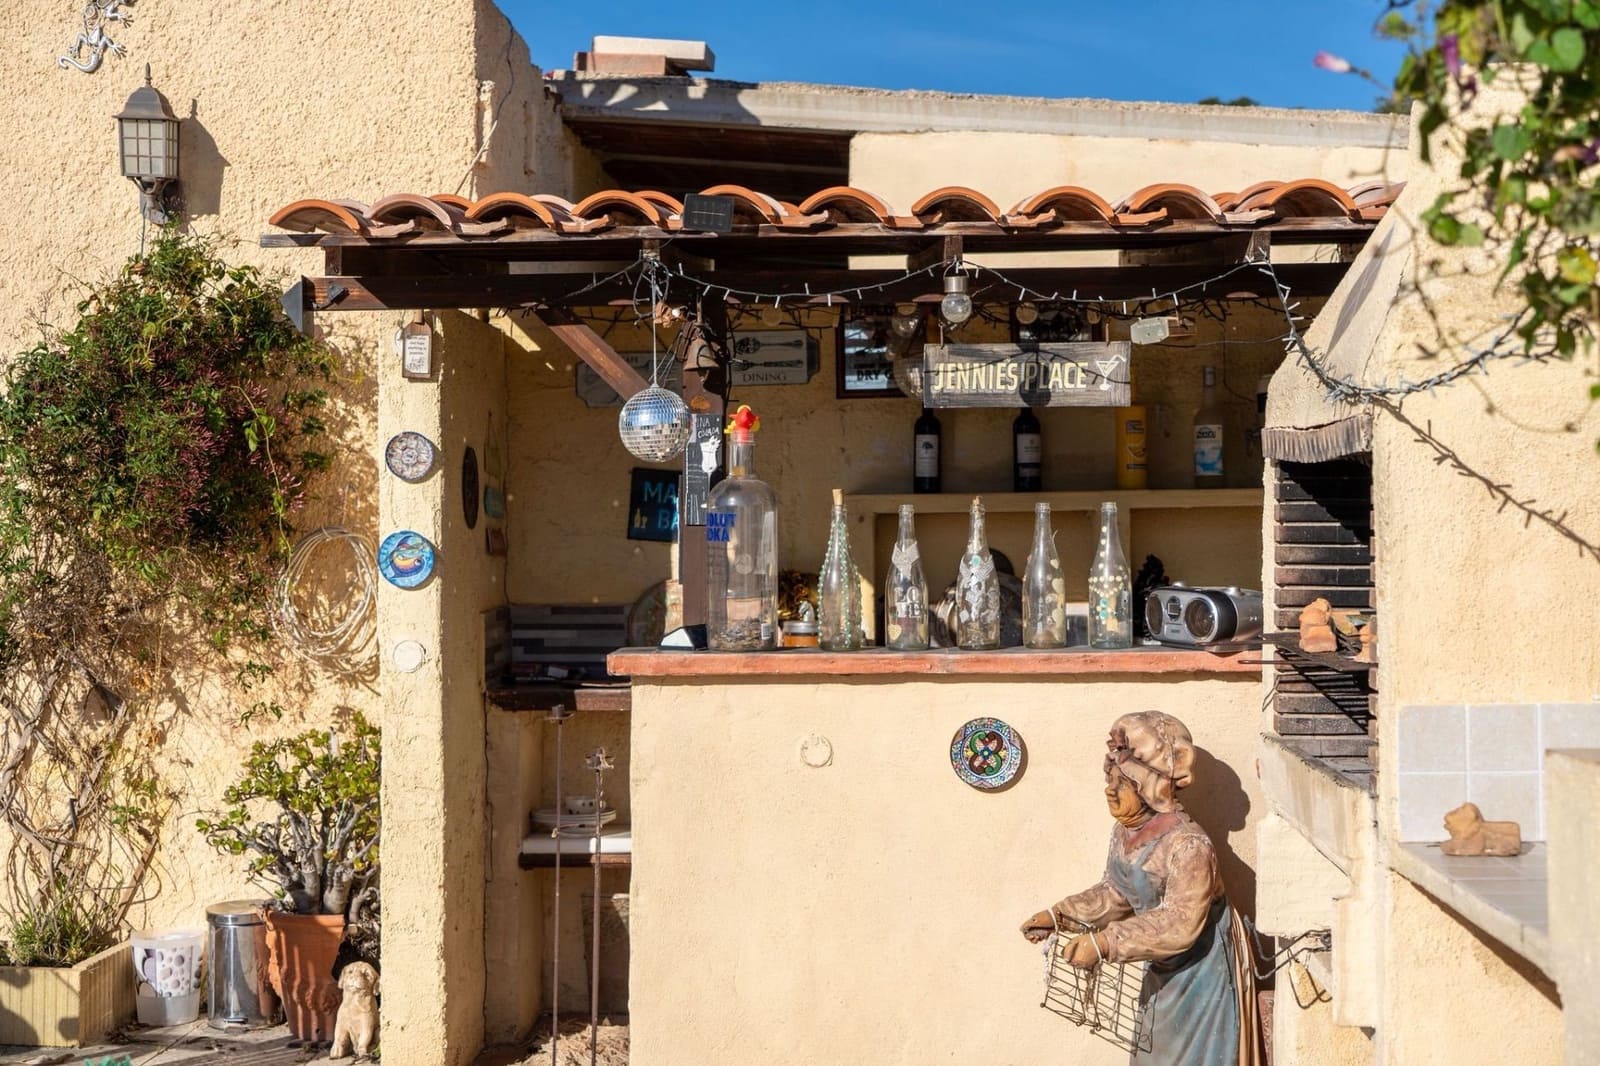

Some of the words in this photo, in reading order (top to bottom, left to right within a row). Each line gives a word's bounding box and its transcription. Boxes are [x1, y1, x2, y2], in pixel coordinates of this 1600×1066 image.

[743, 373, 786, 382] DINING
[857, 369, 881, 381] DRY
[1023, 362, 1088, 390] PLACE
[643, 480, 679, 503] MA
[657, 508, 679, 531] BA
[707, 512, 736, 527] OLUT
[707, 527, 730, 541] DKA
